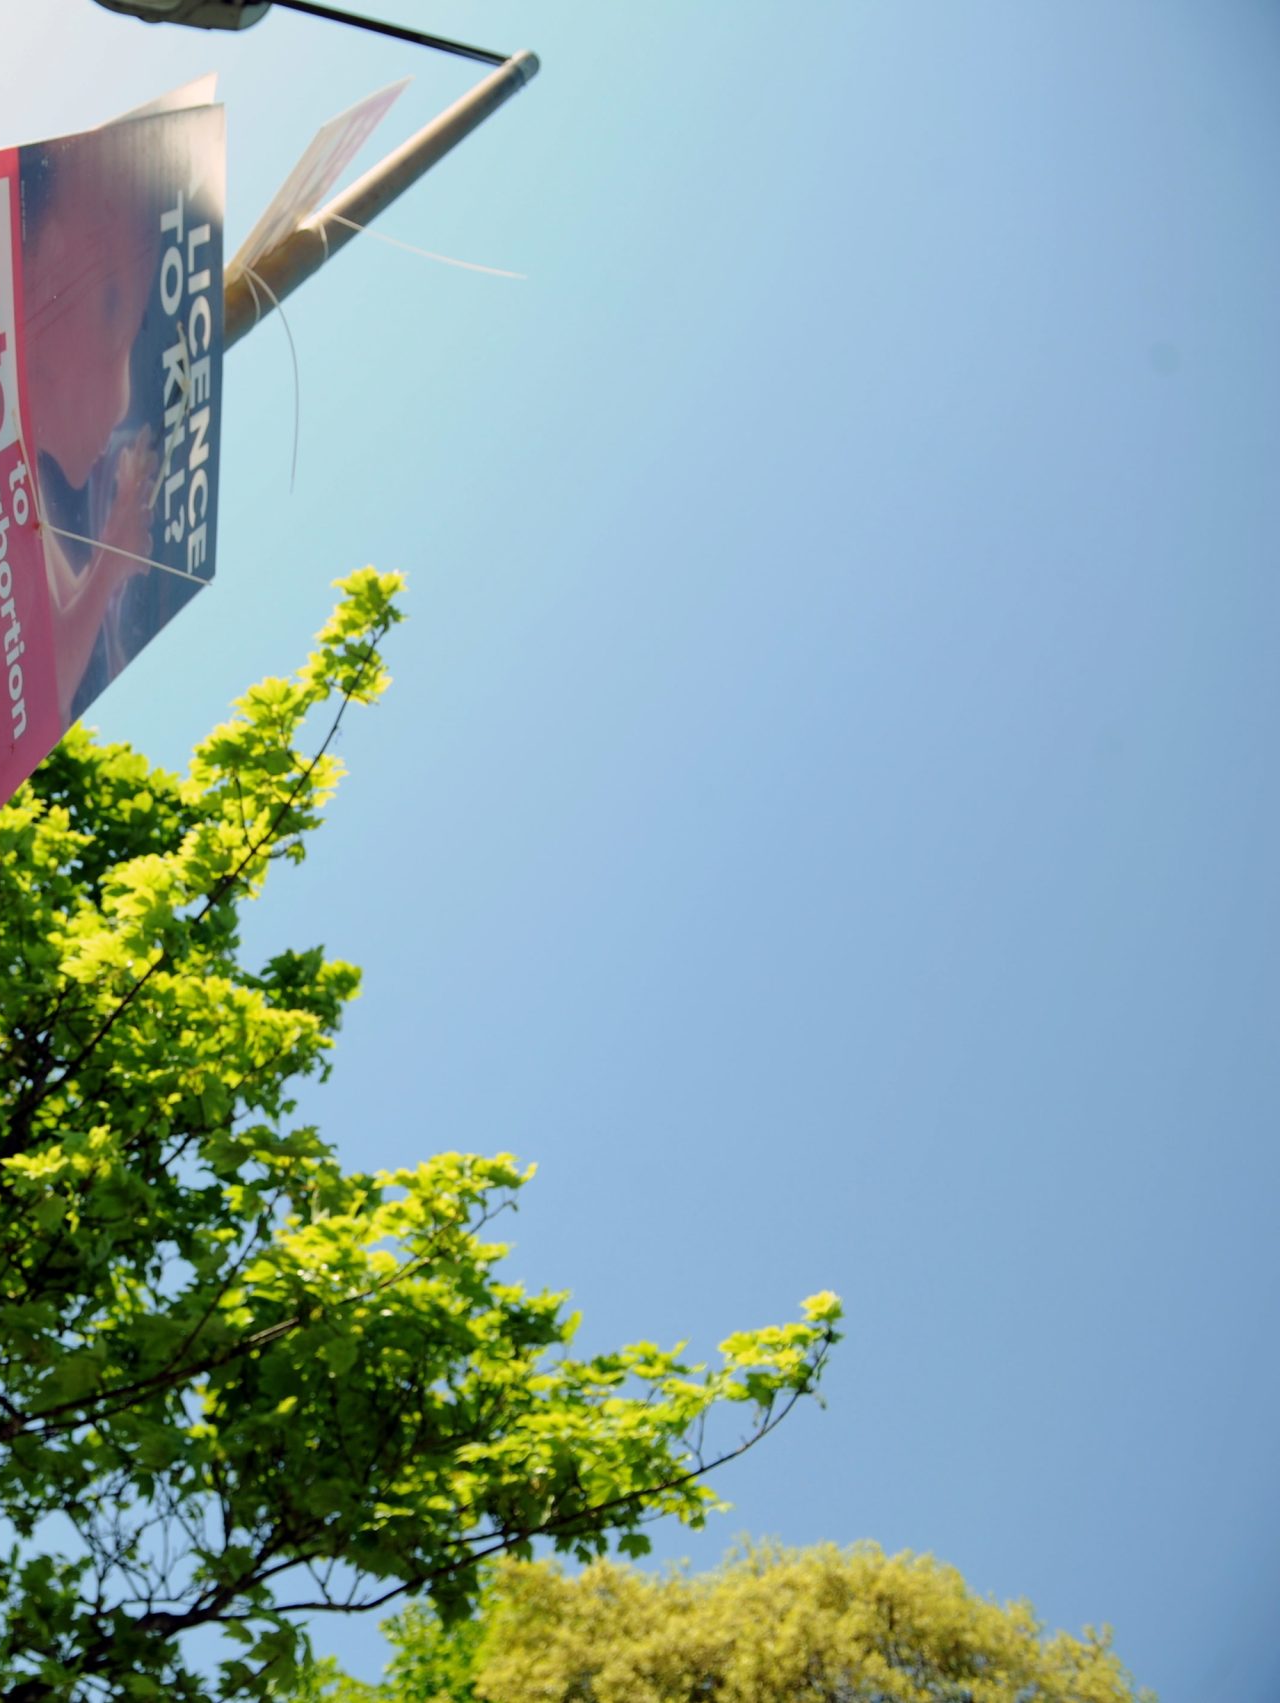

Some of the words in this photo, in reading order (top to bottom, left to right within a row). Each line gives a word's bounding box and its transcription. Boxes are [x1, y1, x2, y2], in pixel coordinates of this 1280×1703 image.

[160, 190, 184, 316] TO
[162, 342, 187, 544] KILL?
[187, 223, 211, 574] LICENCE
[8, 461, 29, 526] to
